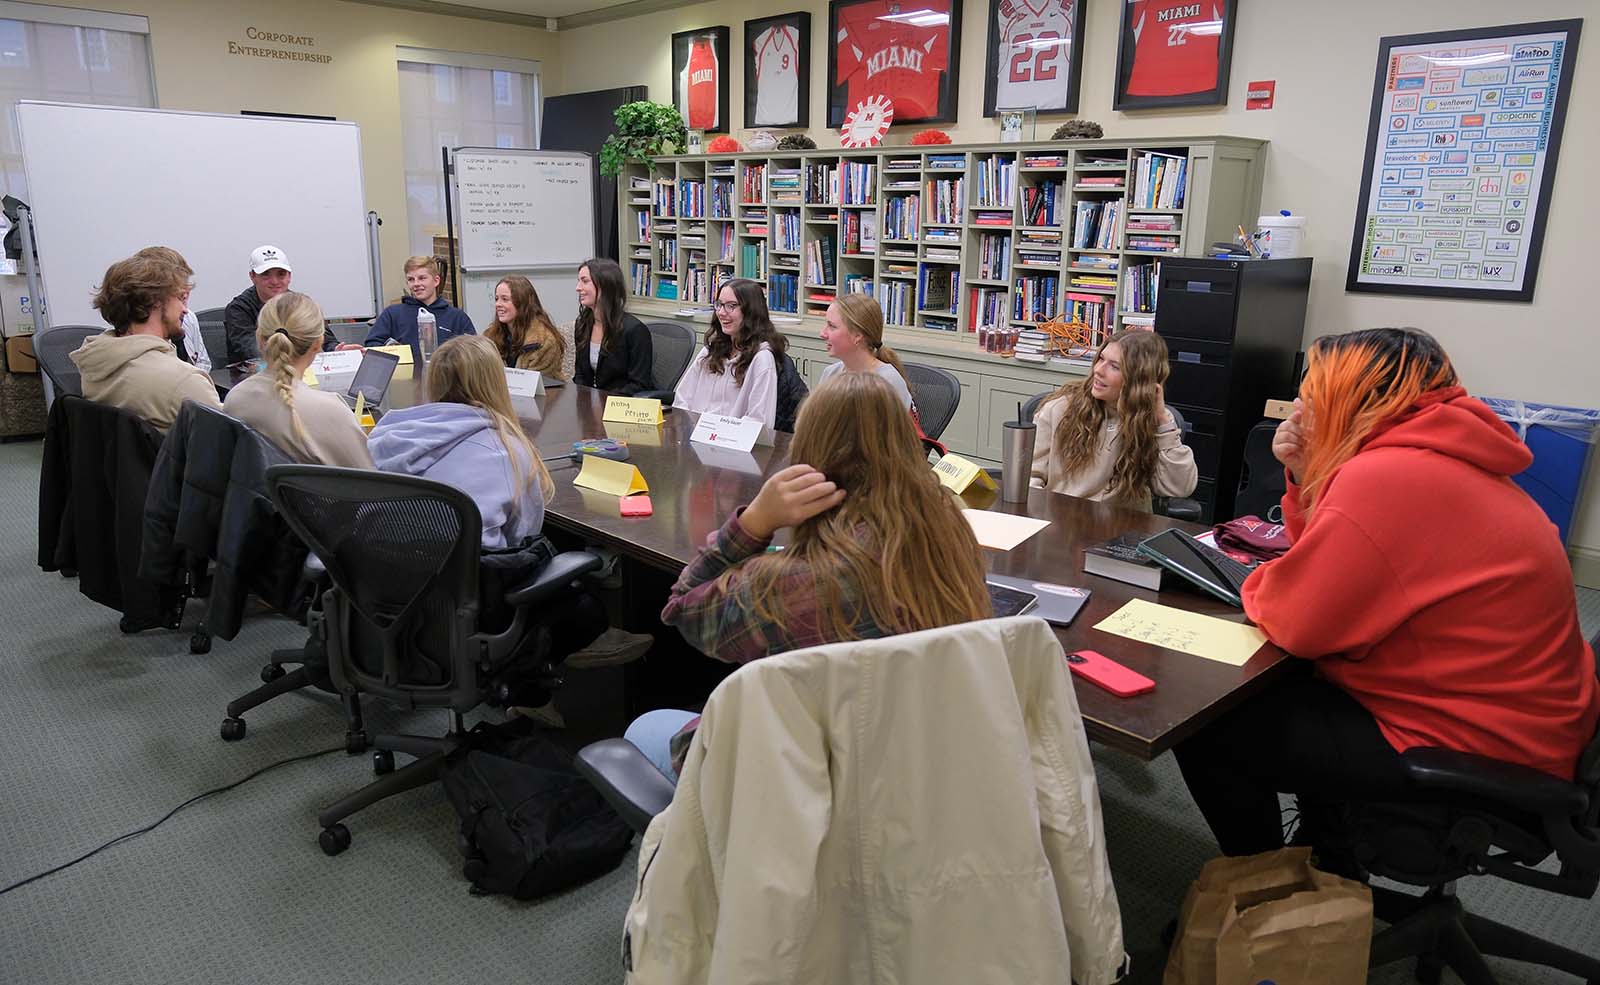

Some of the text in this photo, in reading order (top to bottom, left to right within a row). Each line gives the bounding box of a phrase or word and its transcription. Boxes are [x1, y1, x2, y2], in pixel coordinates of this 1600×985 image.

[1158, 4, 1200, 22] MIAMI
[246, 26, 314, 46] CORPORATE
[1167, 24, 1186, 46] 22
[228, 41, 333, 64] ENTREPRENEURSHIP
[782, 54, 789, 69] 9
[867, 46, 924, 80] MIAMI
[1009, 31, 1060, 83] 22
[692, 69, 712, 86] MIAMI
